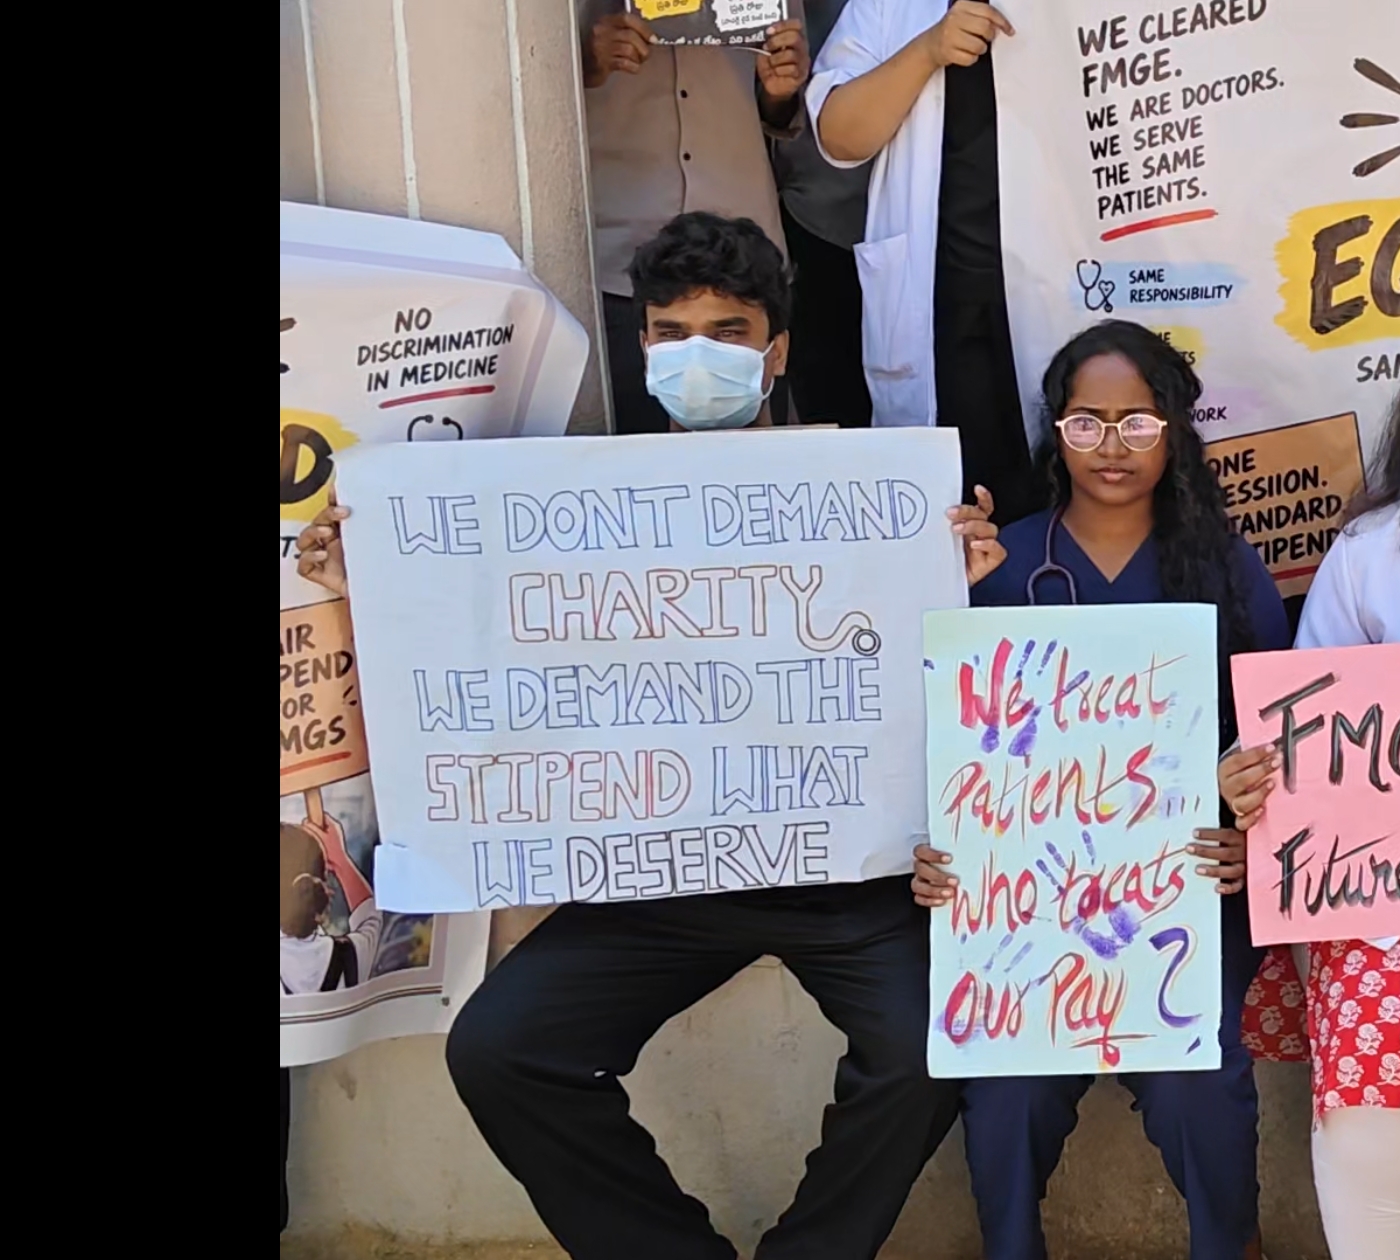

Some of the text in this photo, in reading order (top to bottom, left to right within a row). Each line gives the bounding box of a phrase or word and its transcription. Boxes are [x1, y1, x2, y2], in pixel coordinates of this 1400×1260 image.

[1078, 0, 1267, 57] WE CLEARED
[1082, 48, 1182, 98] FMGE.
[1086, 67, 1285, 131] WE ARE DOCTORS.
[1090, 115, 1203, 161] WE SERVE
[1092, 145, 1205, 189] THE SAME
[1097, 177, 1207, 220] PATIENTS.
[1129, 268, 1165, 284] SAME
[1129, 284, 1233, 303] RESPONSIBILITY
[394, 307, 432, 333] NO
[357, 324, 514, 366] DISCRIMINATION
[367, 354, 499, 392] IN MEDICINE
[1206, 448, 1256, 478] ONE
[1223, 465, 1327, 508] ESSIION.
[388, 495, 483, 555] WE
[702, 479, 928, 547] DEMAND
[1229, 494, 1342, 535] TANDARD
[510, 565, 881, 656] CHARITY
[280, 623, 316, 656] IR
[414, 657, 882, 732] WE DEMAND THE
[958, 637, 1036, 730] We
[427, 745, 868, 824] STIPEND WHAT
[473, 821, 829, 908] WE DESERVE
